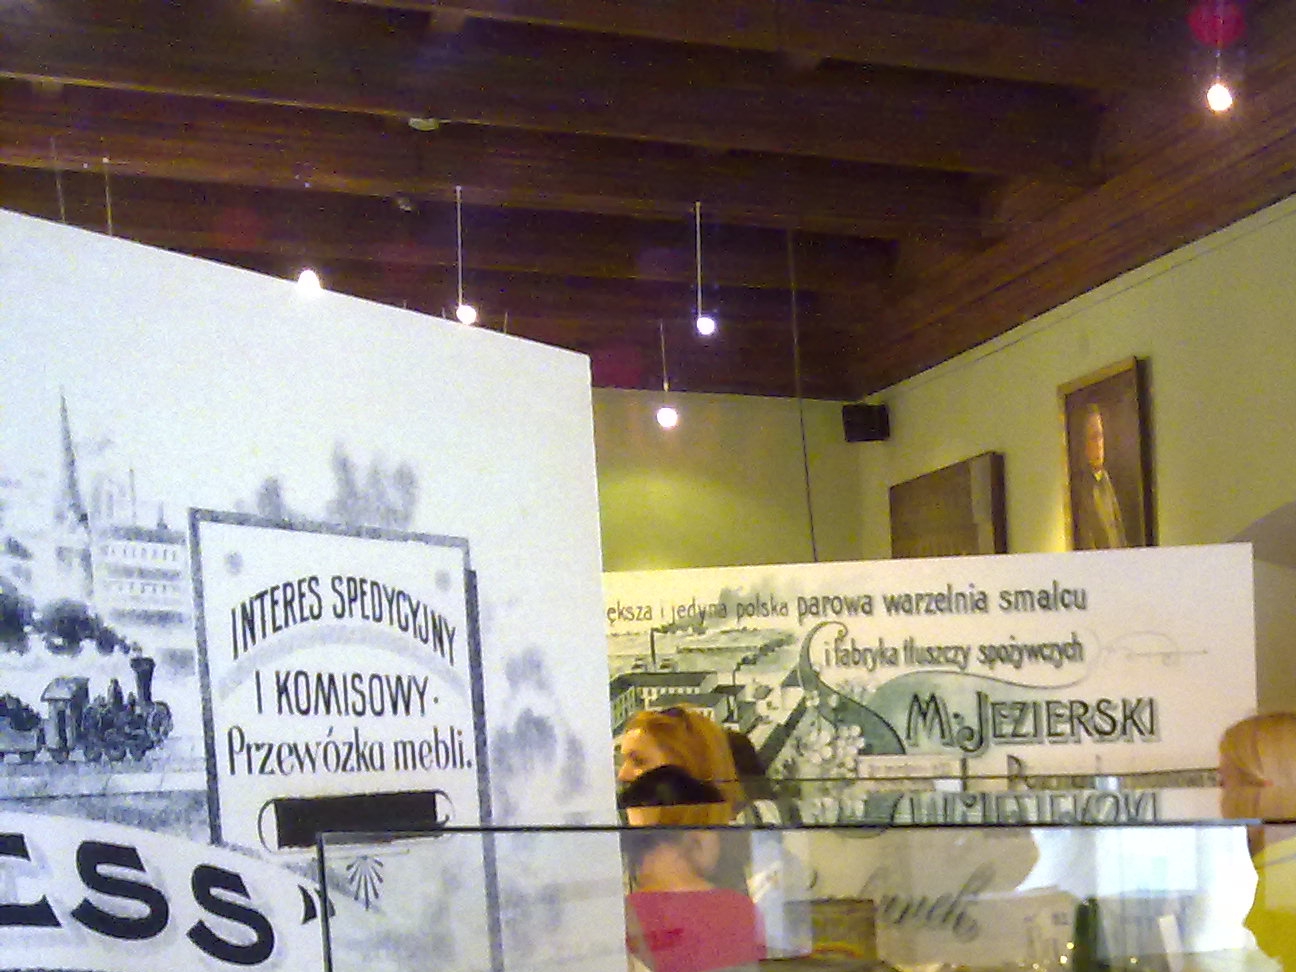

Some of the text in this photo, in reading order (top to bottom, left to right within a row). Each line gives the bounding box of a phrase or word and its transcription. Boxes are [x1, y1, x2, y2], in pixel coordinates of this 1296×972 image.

[231, 575, 456, 666] INTERES SPEDYCYJNY
[671, 596, 728, 627] jedyna
[736, 593, 789, 622] polska
[797, 594, 873, 625] parowa
[883, 583, 988, 616] warzelnia
[999, 579, 1087, 611] smalcu
[834, 636, 899, 672] fabryka
[254, 670, 264, 714] I
[227, 725, 473, 777] Przewózka mebli.
